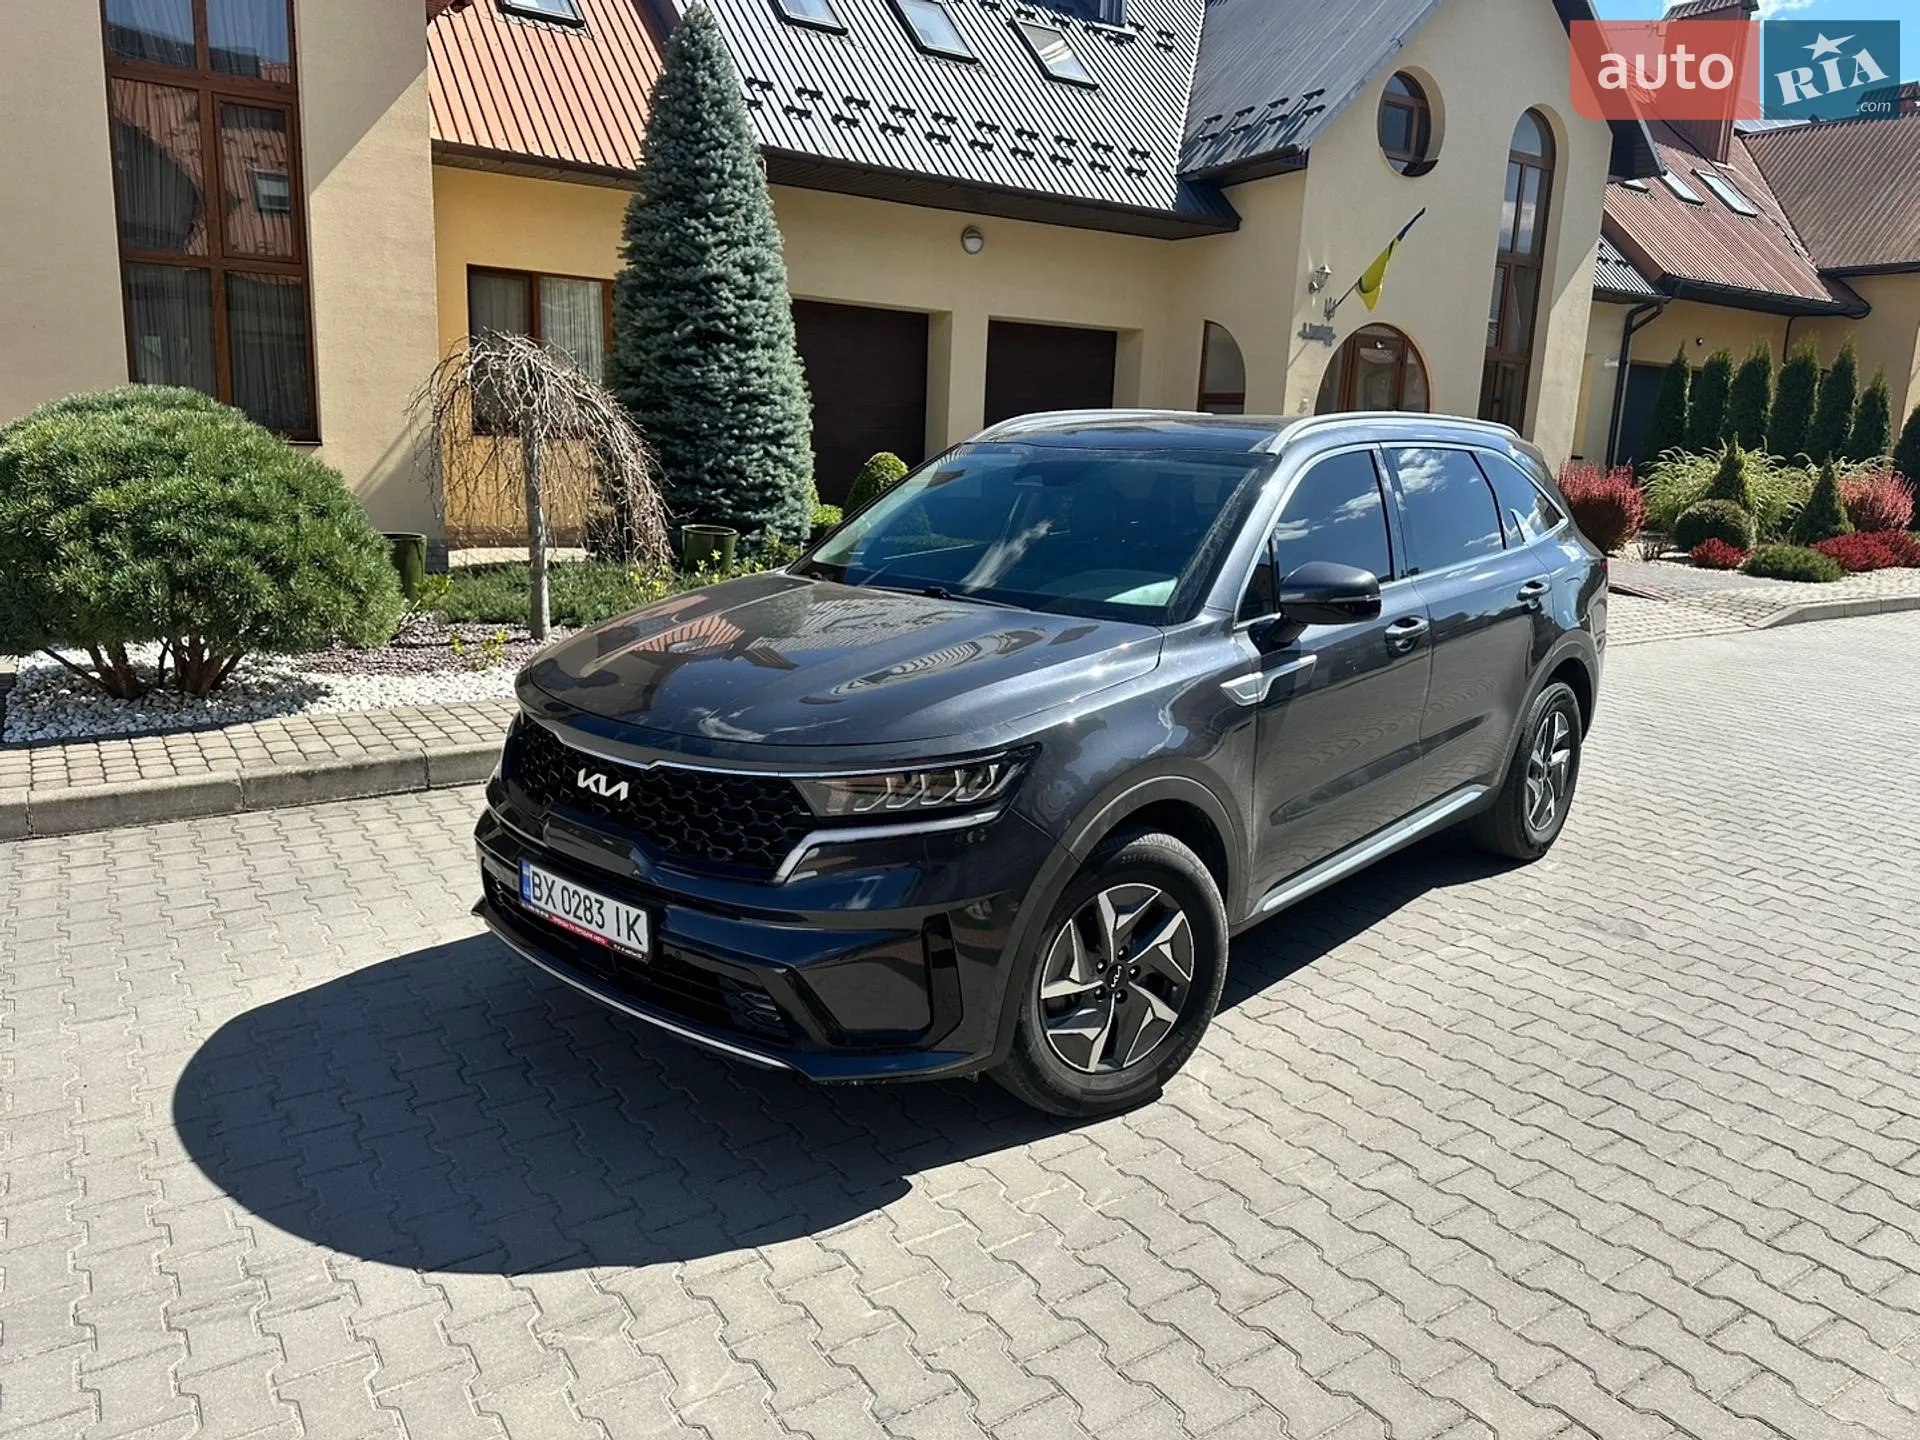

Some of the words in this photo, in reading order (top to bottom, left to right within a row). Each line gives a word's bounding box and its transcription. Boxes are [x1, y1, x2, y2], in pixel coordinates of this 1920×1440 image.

[577, 768, 629, 801] KIA
[532, 870, 558, 910] BX
[561, 885, 606, 929] 0283
[615, 906, 643, 945] IK
